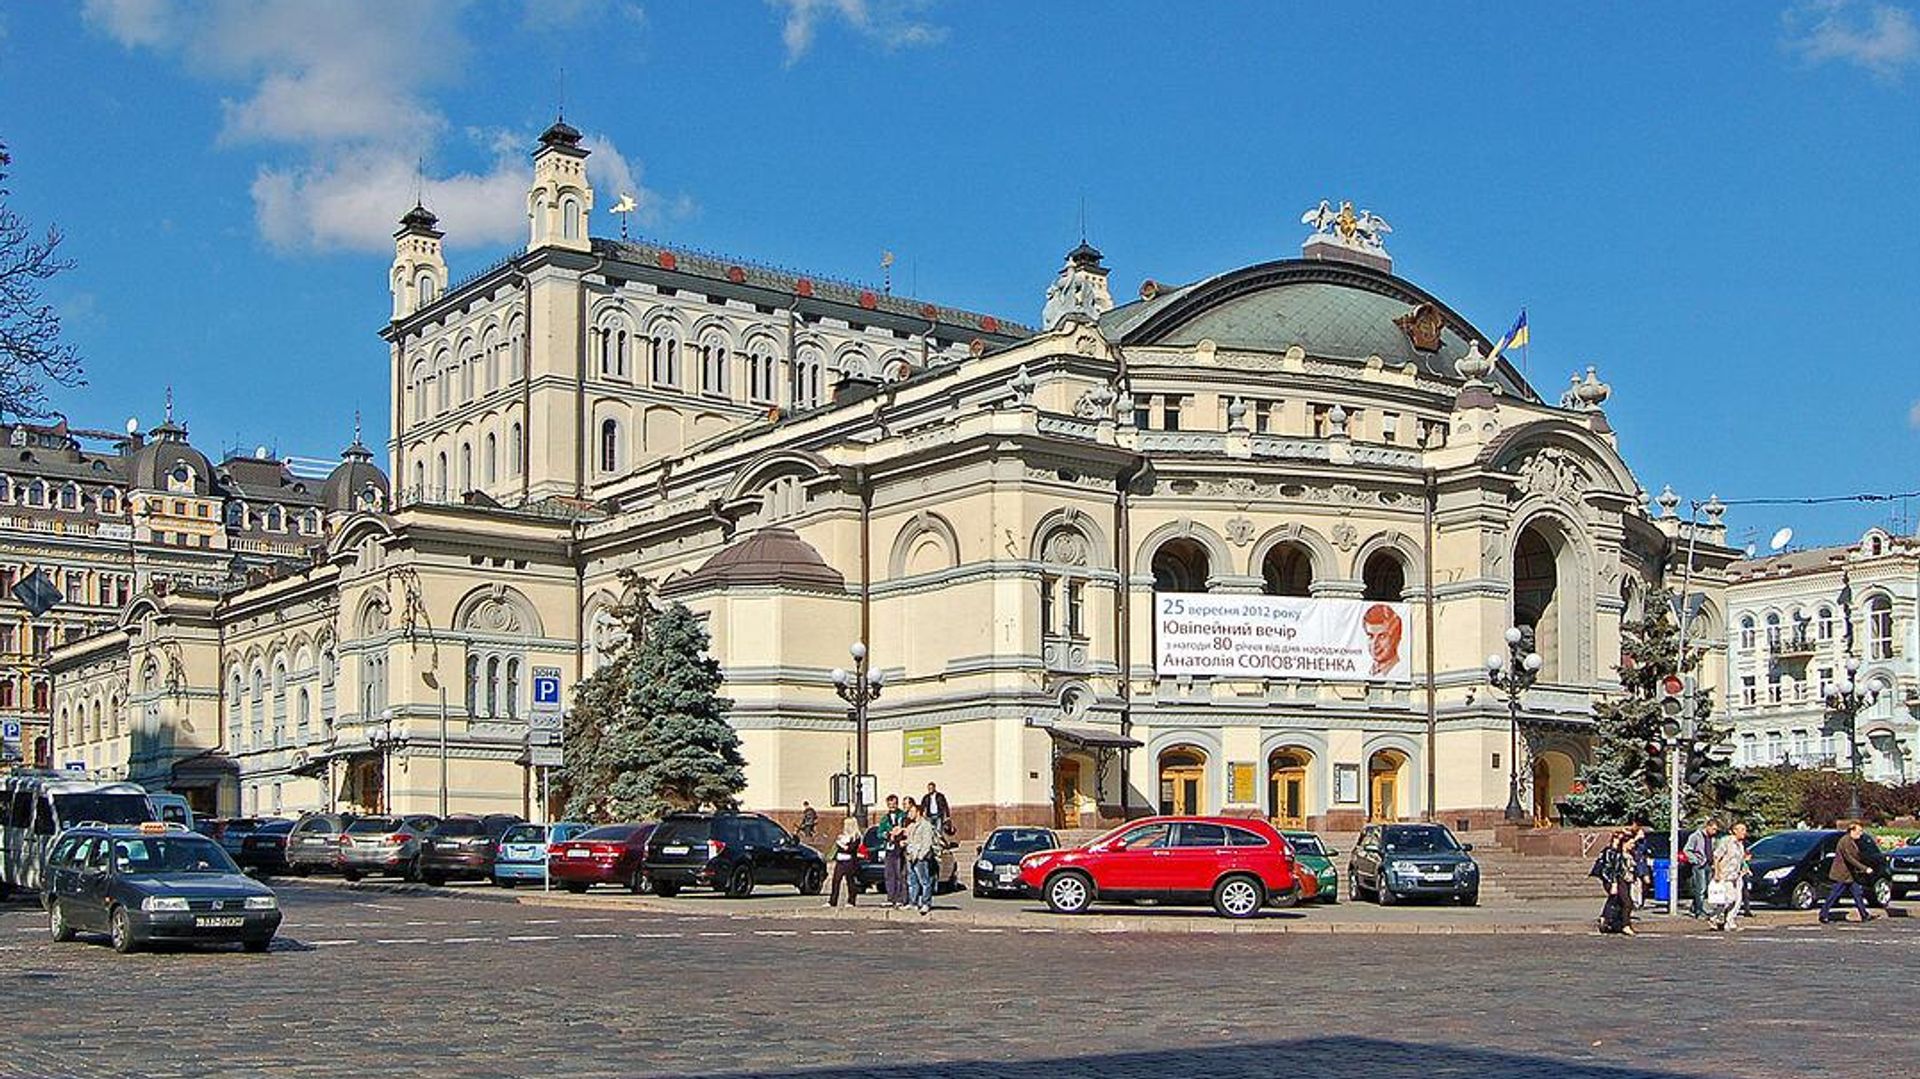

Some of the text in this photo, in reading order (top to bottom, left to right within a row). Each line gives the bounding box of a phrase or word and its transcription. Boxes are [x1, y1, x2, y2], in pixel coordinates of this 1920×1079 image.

[1163, 599, 1302, 621] 25 вересня 2012 року
[1163, 620, 1297, 640] Ювілейний вечір
[1213, 637, 1233, 650] 80
[1163, 653, 1356, 671] Анатолія СОЛОВ'ЯНЕНКА
[540, 681, 555, 700] P
